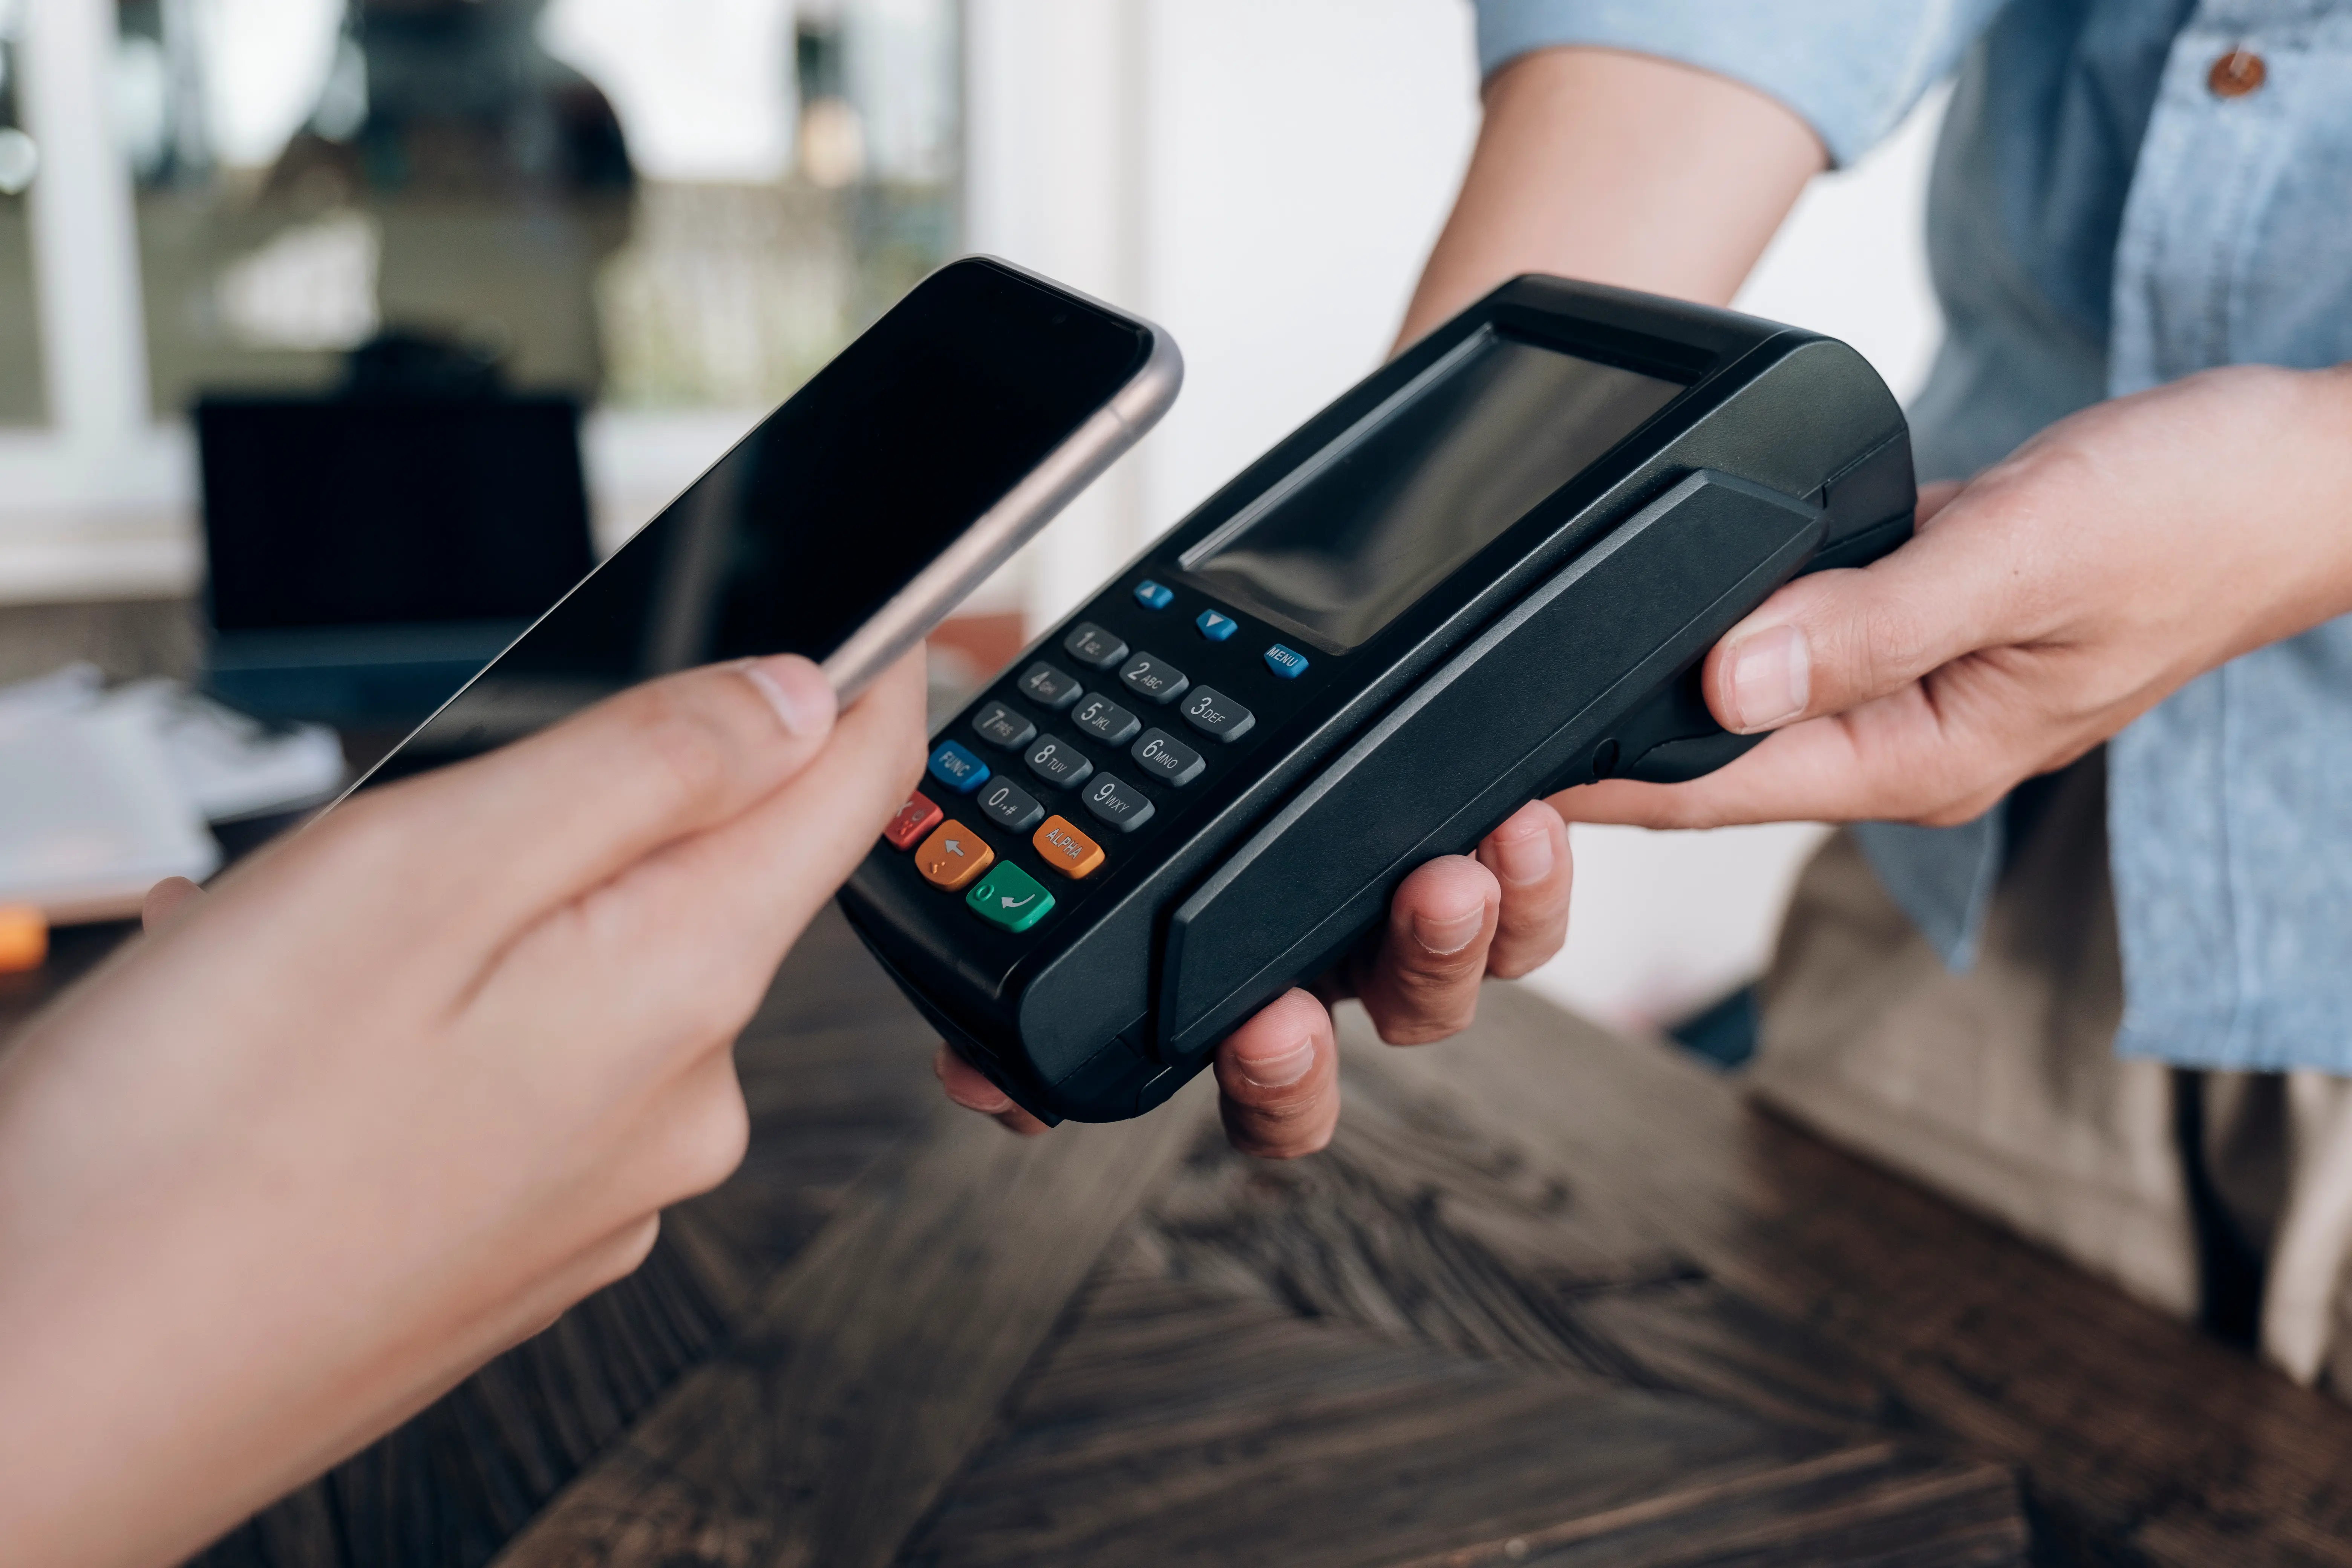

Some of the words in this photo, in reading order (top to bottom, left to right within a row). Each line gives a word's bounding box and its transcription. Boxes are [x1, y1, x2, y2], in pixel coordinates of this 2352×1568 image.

[1076, 631, 1095, 648] 1
[1266, 647, 1298, 667] MENU
[1031, 671, 1050, 688] 4
[1127, 662, 1150, 680] 2
[1140, 674, 1162, 689] ABC
[982, 709, 1005, 729] 7
[1081, 702, 1103, 720] 5
[1092, 716, 1110, 730] JKL
[1191, 697, 1212, 715] 3
[1202, 709, 1225, 724] DEF
[939, 751, 970, 776] FUNC
[1034, 744, 1056, 763] 8
[1047, 758, 1067, 773] TUV
[1142, 739, 1164, 757] 6
[1153, 751, 1178, 769] MNO
[988, 787, 1009, 806] 0
[1094, 783, 1115, 801] 9
[1105, 795, 1130, 813] WXY
[1045, 828, 1083, 859] ALPHA
